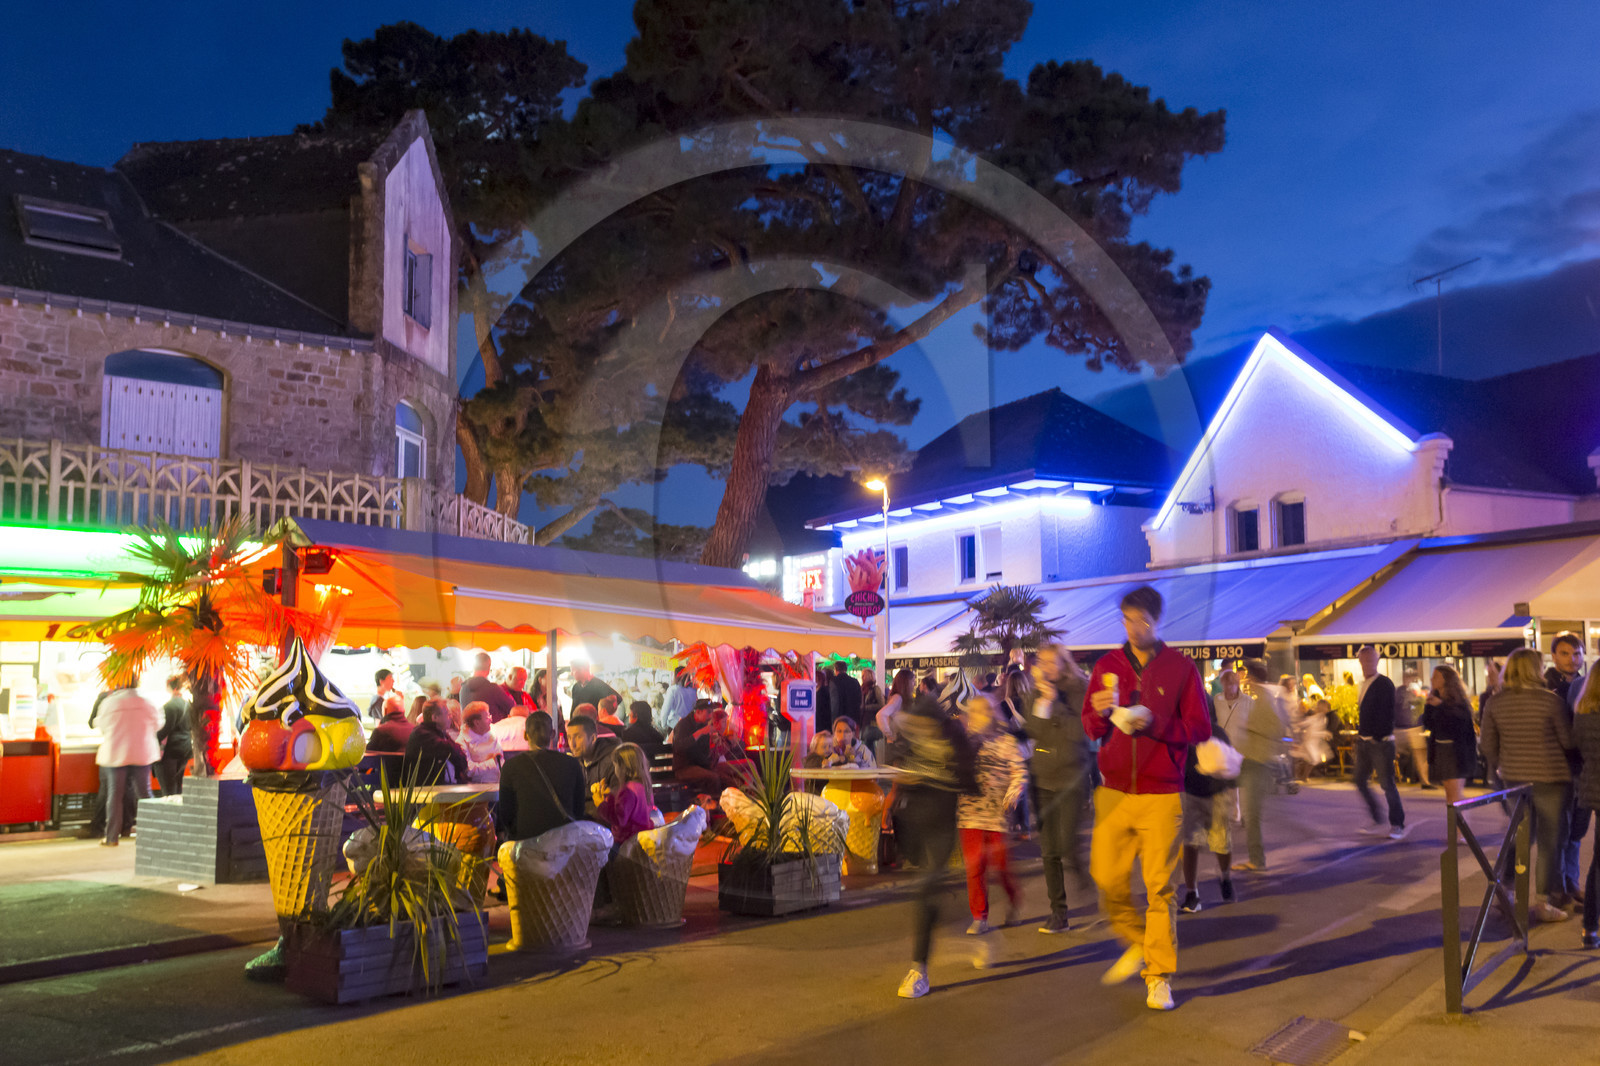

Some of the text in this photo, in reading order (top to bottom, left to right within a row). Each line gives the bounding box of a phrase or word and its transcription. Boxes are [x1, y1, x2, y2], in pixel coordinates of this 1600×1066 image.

[848, 604, 881, 616] CHURROS
[1178, 646, 1244, 659] PUIS 1930
[919, 656, 960, 668] BRASSERIE
